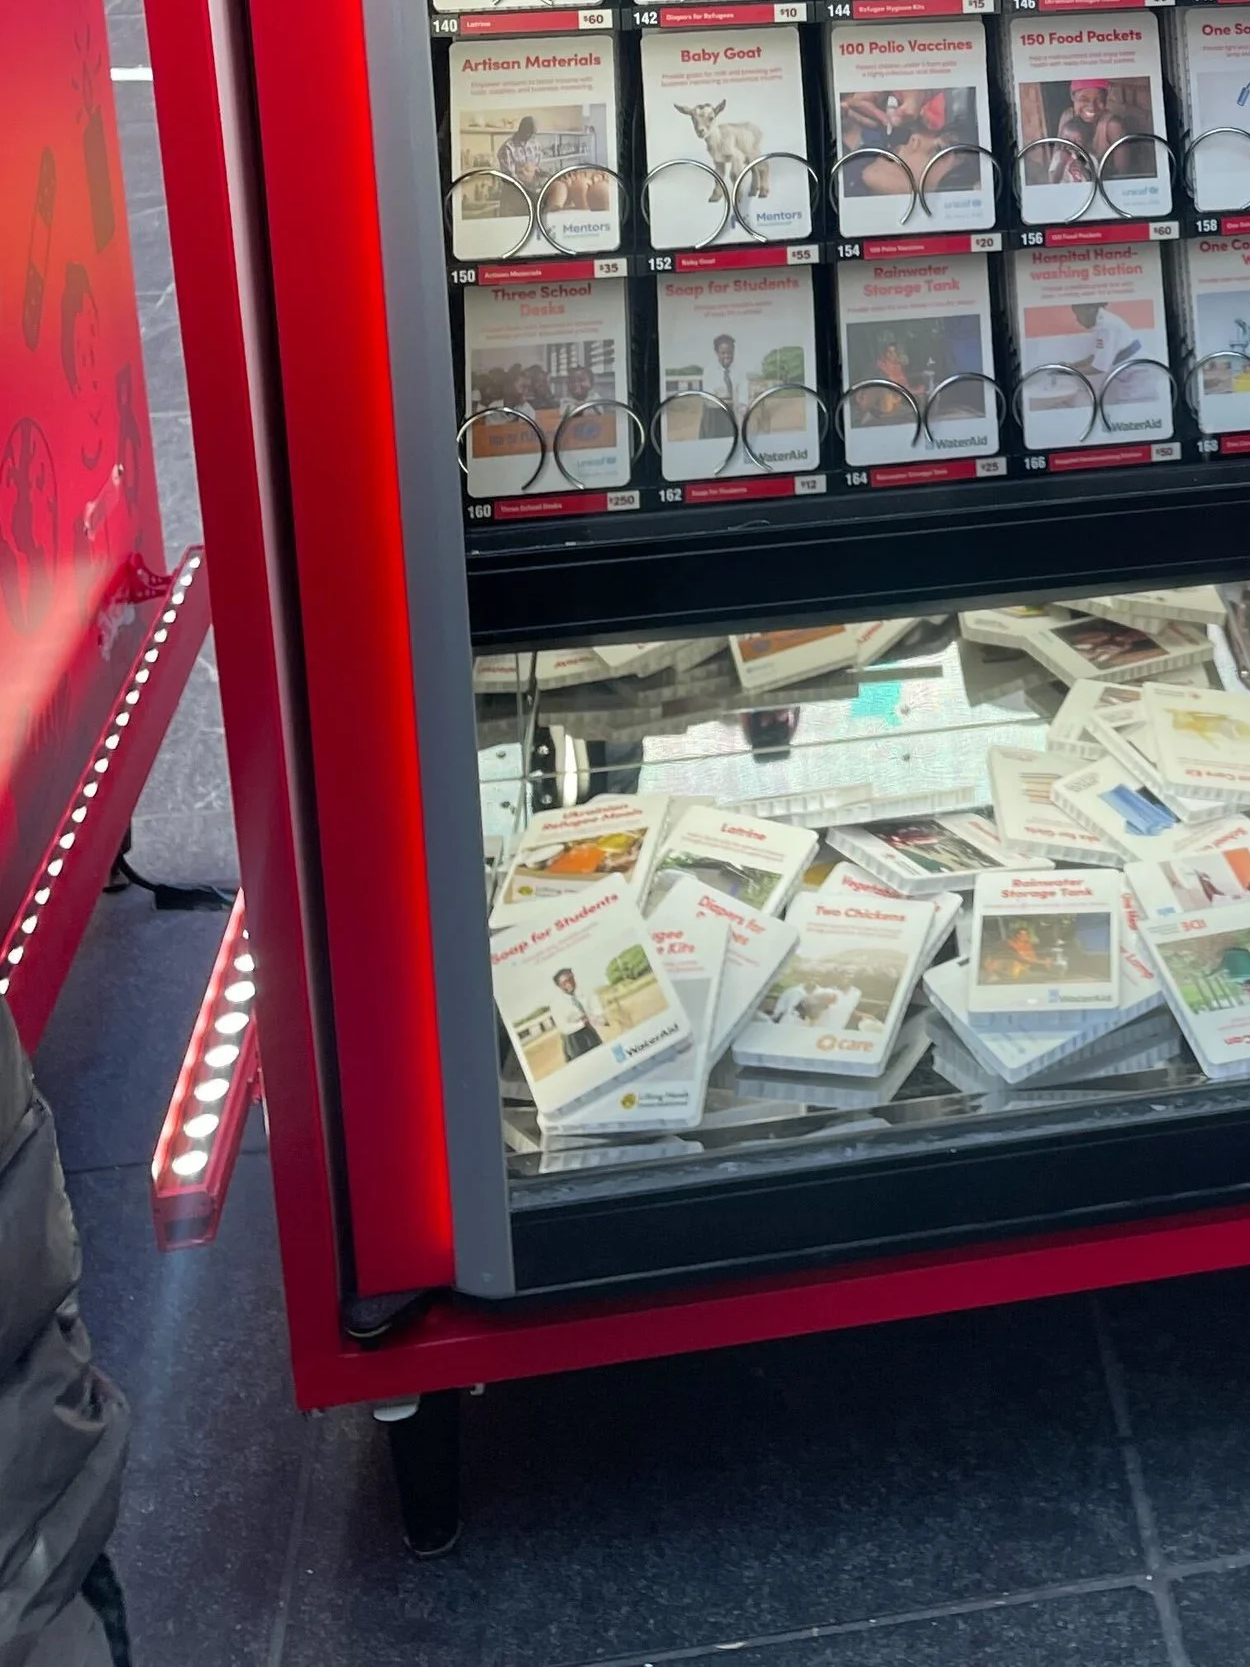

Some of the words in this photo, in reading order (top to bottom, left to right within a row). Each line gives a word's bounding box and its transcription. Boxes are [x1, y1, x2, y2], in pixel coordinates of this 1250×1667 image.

[633, 11, 658, 26] 142
[827, 3, 851, 18] 144
[433, 18, 458, 34] 140
[1202, 24, 1231, 37] One
[1020, 33, 1045, 46] 150
[1048, 32, 1083, 45] Food
[1087, 29, 1142, 43] Packets
[839, 43, 865, 56] 100
[868, 40, 905, 55] Polio
[907, 38, 974, 53] Vaccines
[462, 57, 521, 73] Artisan
[525, 53, 602, 69] Materials
[681, 50, 719, 66] Baby
[723, 47, 762, 61] Goat
[756, 210, 803, 223] Mentors
[1021, 232, 1043, 245] 156
[1200, 239, 1228, 252] One
[837, 244, 860, 258] 154
[648, 257, 673, 272] 152
[1032, 250, 1091, 269] Hospital
[451, 269, 476, 284] 150
[873, 264, 949, 280] Rainwater
[1030, 266, 1090, 283] washing
[1093, 262, 1143, 277] Station
[491, 287, 536, 302] Three
[540, 284, 592, 299] School
[665, 283, 704, 300] Soap
[708, 281, 731, 295] for
[735, 277, 799, 293] Students
[863, 280, 920, 298] Storage
[923, 278, 960, 293] Tank
[520, 302, 565, 316] Desks
[720, 822, 768, 841] Latrine
[1060, 886, 1093, 898] Tank
[815, 904, 842, 917] Two
[844, 906, 906, 922] Chickens
[836, 1037, 874, 1053] care
